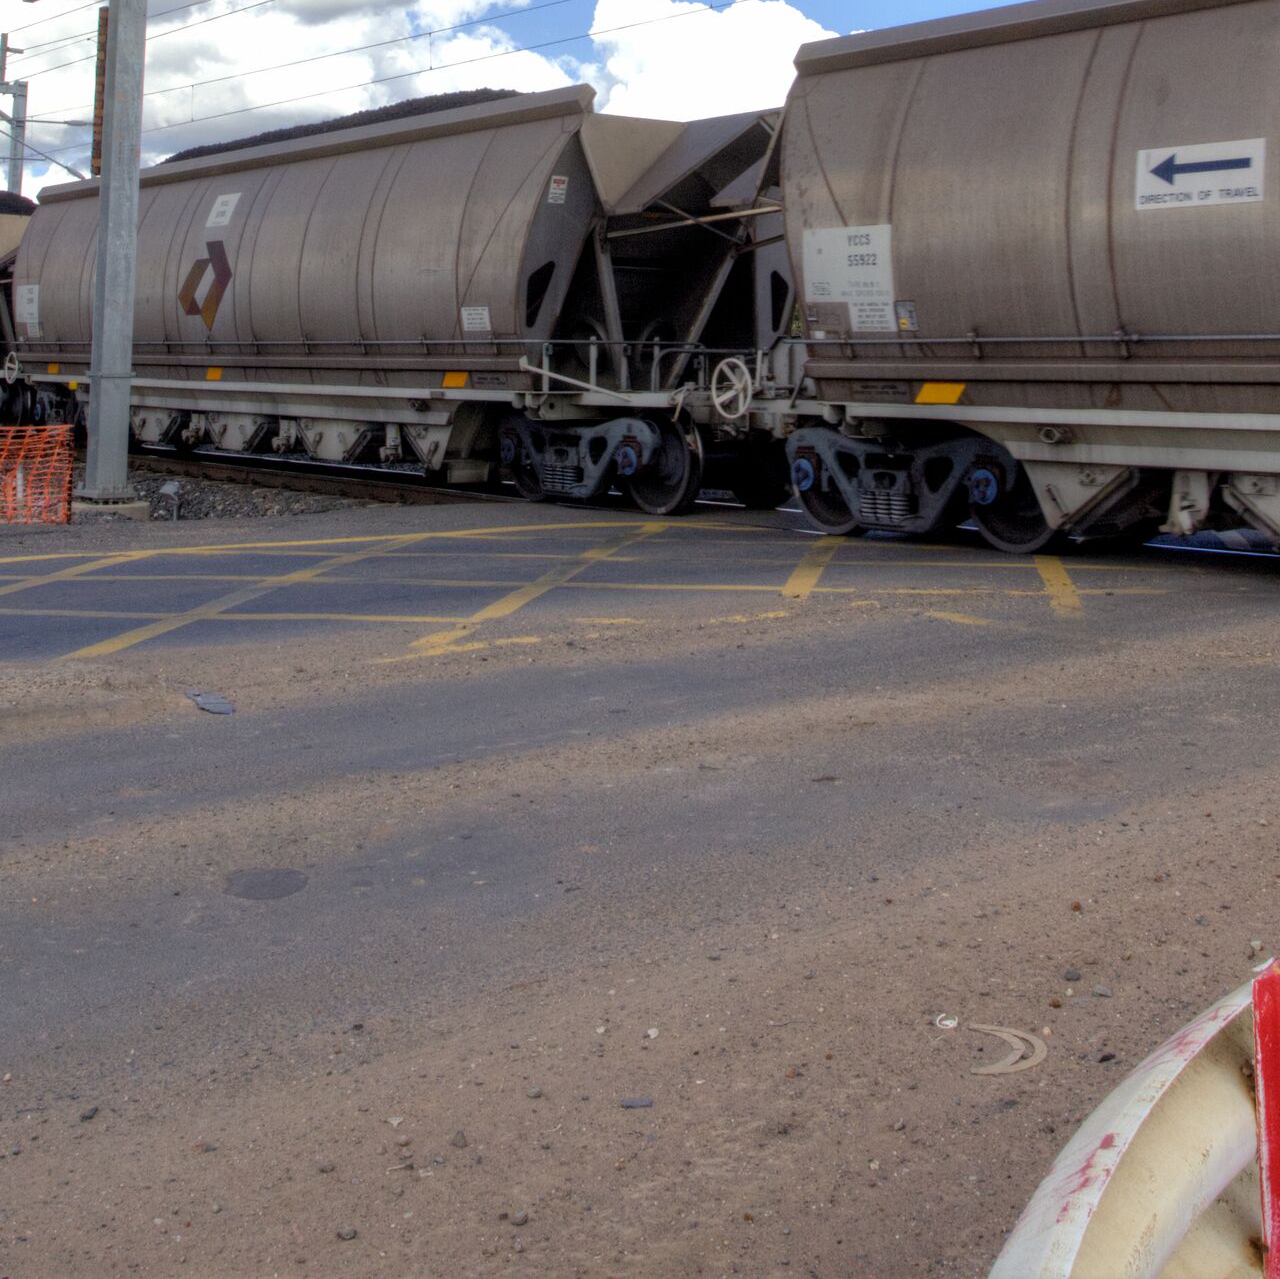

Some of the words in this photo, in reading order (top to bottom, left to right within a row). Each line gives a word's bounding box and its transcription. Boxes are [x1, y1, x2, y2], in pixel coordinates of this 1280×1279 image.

[1139, 192, 1193, 205] DIRECTION
[1198, 190, 1213, 201] OF
[1218, 186, 1259, 199] TRAVEL
